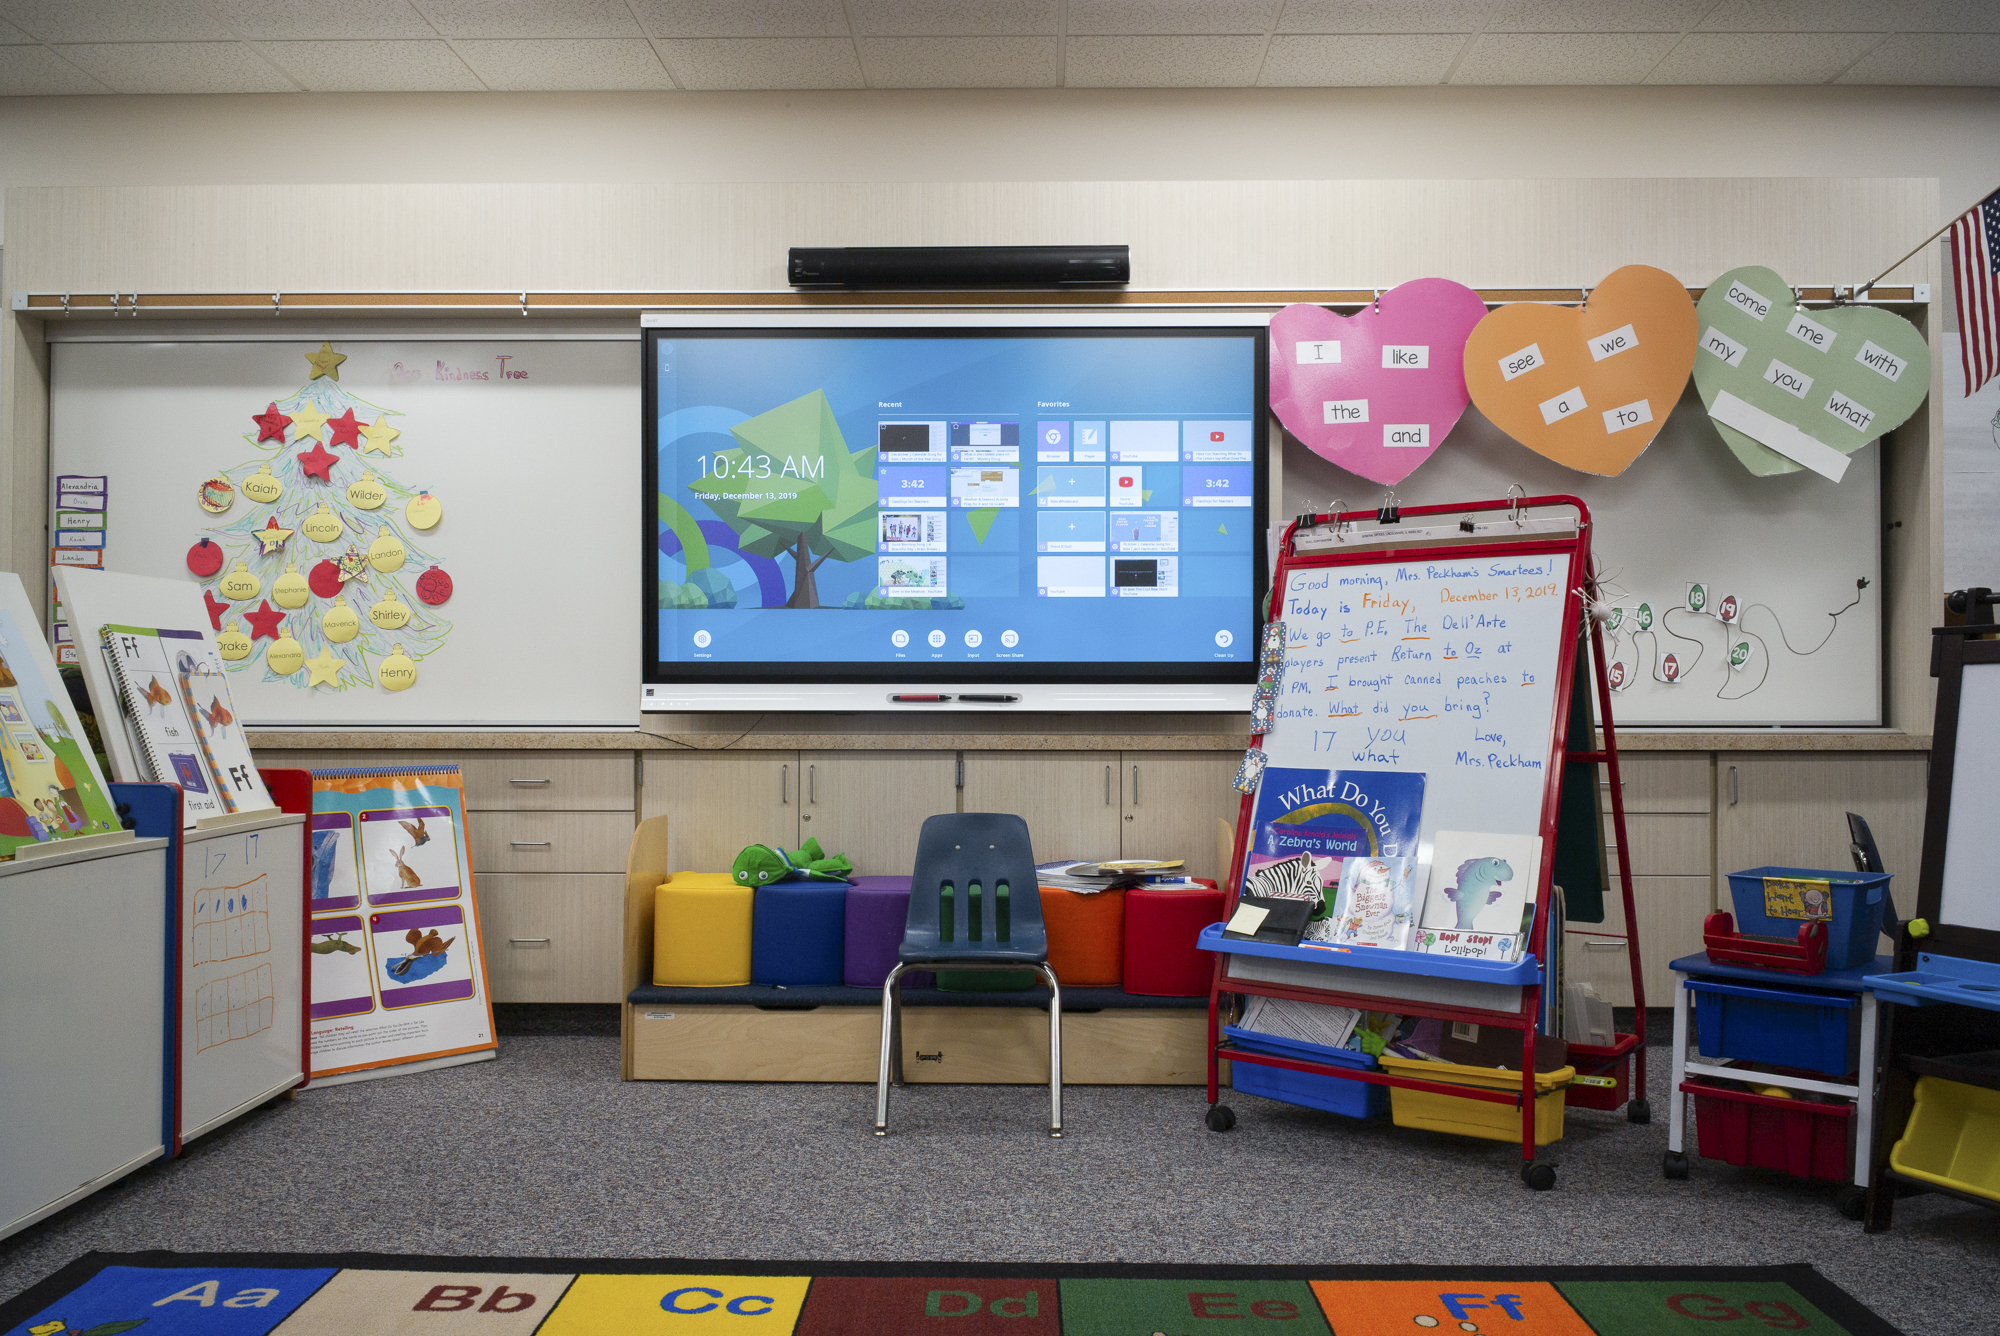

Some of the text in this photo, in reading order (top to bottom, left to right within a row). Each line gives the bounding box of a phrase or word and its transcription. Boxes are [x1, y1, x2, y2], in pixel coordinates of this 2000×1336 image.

[1728, 287, 1768, 316] come
[1797, 324, 1824, 345] me
[1314, 344, 1323, 360] I
[1601, 336, 1626, 353] we
[1708, 337, 1736, 361] my
[1392, 349, 1418, 364] like
[1508, 354, 1536, 374] see
[1864, 350, 1898, 376] with
[436, 360, 489, 381] Kindness
[496, 355, 529, 380] Tree
[1773, 369, 1802, 392] you
[1332, 404, 1360, 420] the
[1558, 401, 1570, 413] a
[1830, 398, 1870, 428] what
[1616, 410, 1638, 426] to
[1391, 428, 1422, 443] and
[697, 455, 824, 479] 10:43 AM
[61, 482, 99, 490] Alexandria
[245, 482, 278, 494] Kaiah
[901, 480, 924, 488] 3:42
[1206, 480, 1230, 488] 3:42
[350, 490, 384, 500] Wilder
[694, 492, 722, 500] Friday,
[765, 492, 776, 500] 13,
[68, 517, 90, 527] Henry
[306, 524, 339, 532] Lincoln
[370, 549, 402, 560] Landon
[227, 581, 252, 592] Sam
[1290, 572, 1329, 591] Good
[1340, 573, 1388, 590] morning,
[1396, 568, 1420, 582] Mrs.
[1426, 566, 1480, 580] Peckham's
[1288, 598, 1327, 620] Today
[1340, 601, 1351, 613] is
[1362, 592, 1415, 616] Friday,
[1441, 587, 1498, 603] December
[1505, 586, 1521, 602] 13,
[1690, 592, 1704, 605] 18
[372, 610, 406, 621] Shirley
[1637, 610, 1651, 622] 16
[1720, 603, 1735, 616] 19
[324, 620, 356, 628] Maverick
[1289, 628, 1308, 642] We
[1316, 632, 1331, 647] go
[1341, 624, 1353, 637] to
[1405, 616, 1427, 633] The
[1442, 614, 1506, 630] Dell'Arte
[121, 636, 140, 658] Ff
[1732, 648, 1748, 659] 20
[1283, 658, 1324, 677] players
[1337, 650, 1377, 670] present
[1391, 645, 1432, 662] Return
[1444, 642, 1456, 656] to
[1498, 641, 1512, 654] at
[380, 668, 414, 678] Henry
[1610, 669, 1622, 682] 15
[1664, 662, 1676, 675] 17
[1292, 682, 1311, 694] PM.
[1326, 675, 1338, 689] I
[1349, 674, 1393, 692] brought
[1404, 672, 1441, 684] canned
[1457, 672, 1507, 689] peaches
[1522, 670, 1535, 682] to
[1277, 691, 1490, 719] donate. What did you bring?
[164, 727, 179, 737] fish
[1314, 727, 1406, 751] 17 you
[1475, 727, 1506, 747] Love,
[1352, 749, 1399, 765] what
[1455, 751, 1542, 769] Mrs. Peckham
[228, 764, 253, 791] Ff
[188, 800, 215, 810] first aid
[1278, 784, 1336, 810] What
[1340, 781, 1368, 807] Do
[1369, 800, 1391, 837] You
[1274, 828, 1302, 836] Caroline
[1304, 830, 1330, 838] Arnold's
[1267, 835, 1358, 852] A Zebra's World
[1356, 893, 1386, 903] Biggest
[1355, 902, 1388, 912] Snowman
[1768, 906, 1777, 916] to
[1467, 934, 1493, 946] Stop!
[152, 1280, 280, 1307] Aa
[412, 1285, 537, 1313] Bb
[660, 1286, 775, 1316] Cc
[924, 1290, 1038, 1318] Dd
[1187, 1292, 1300, 1320] Ee
[1439, 1293, 1524, 1321] Ff
[1666, 1293, 1811, 1329] Gg
